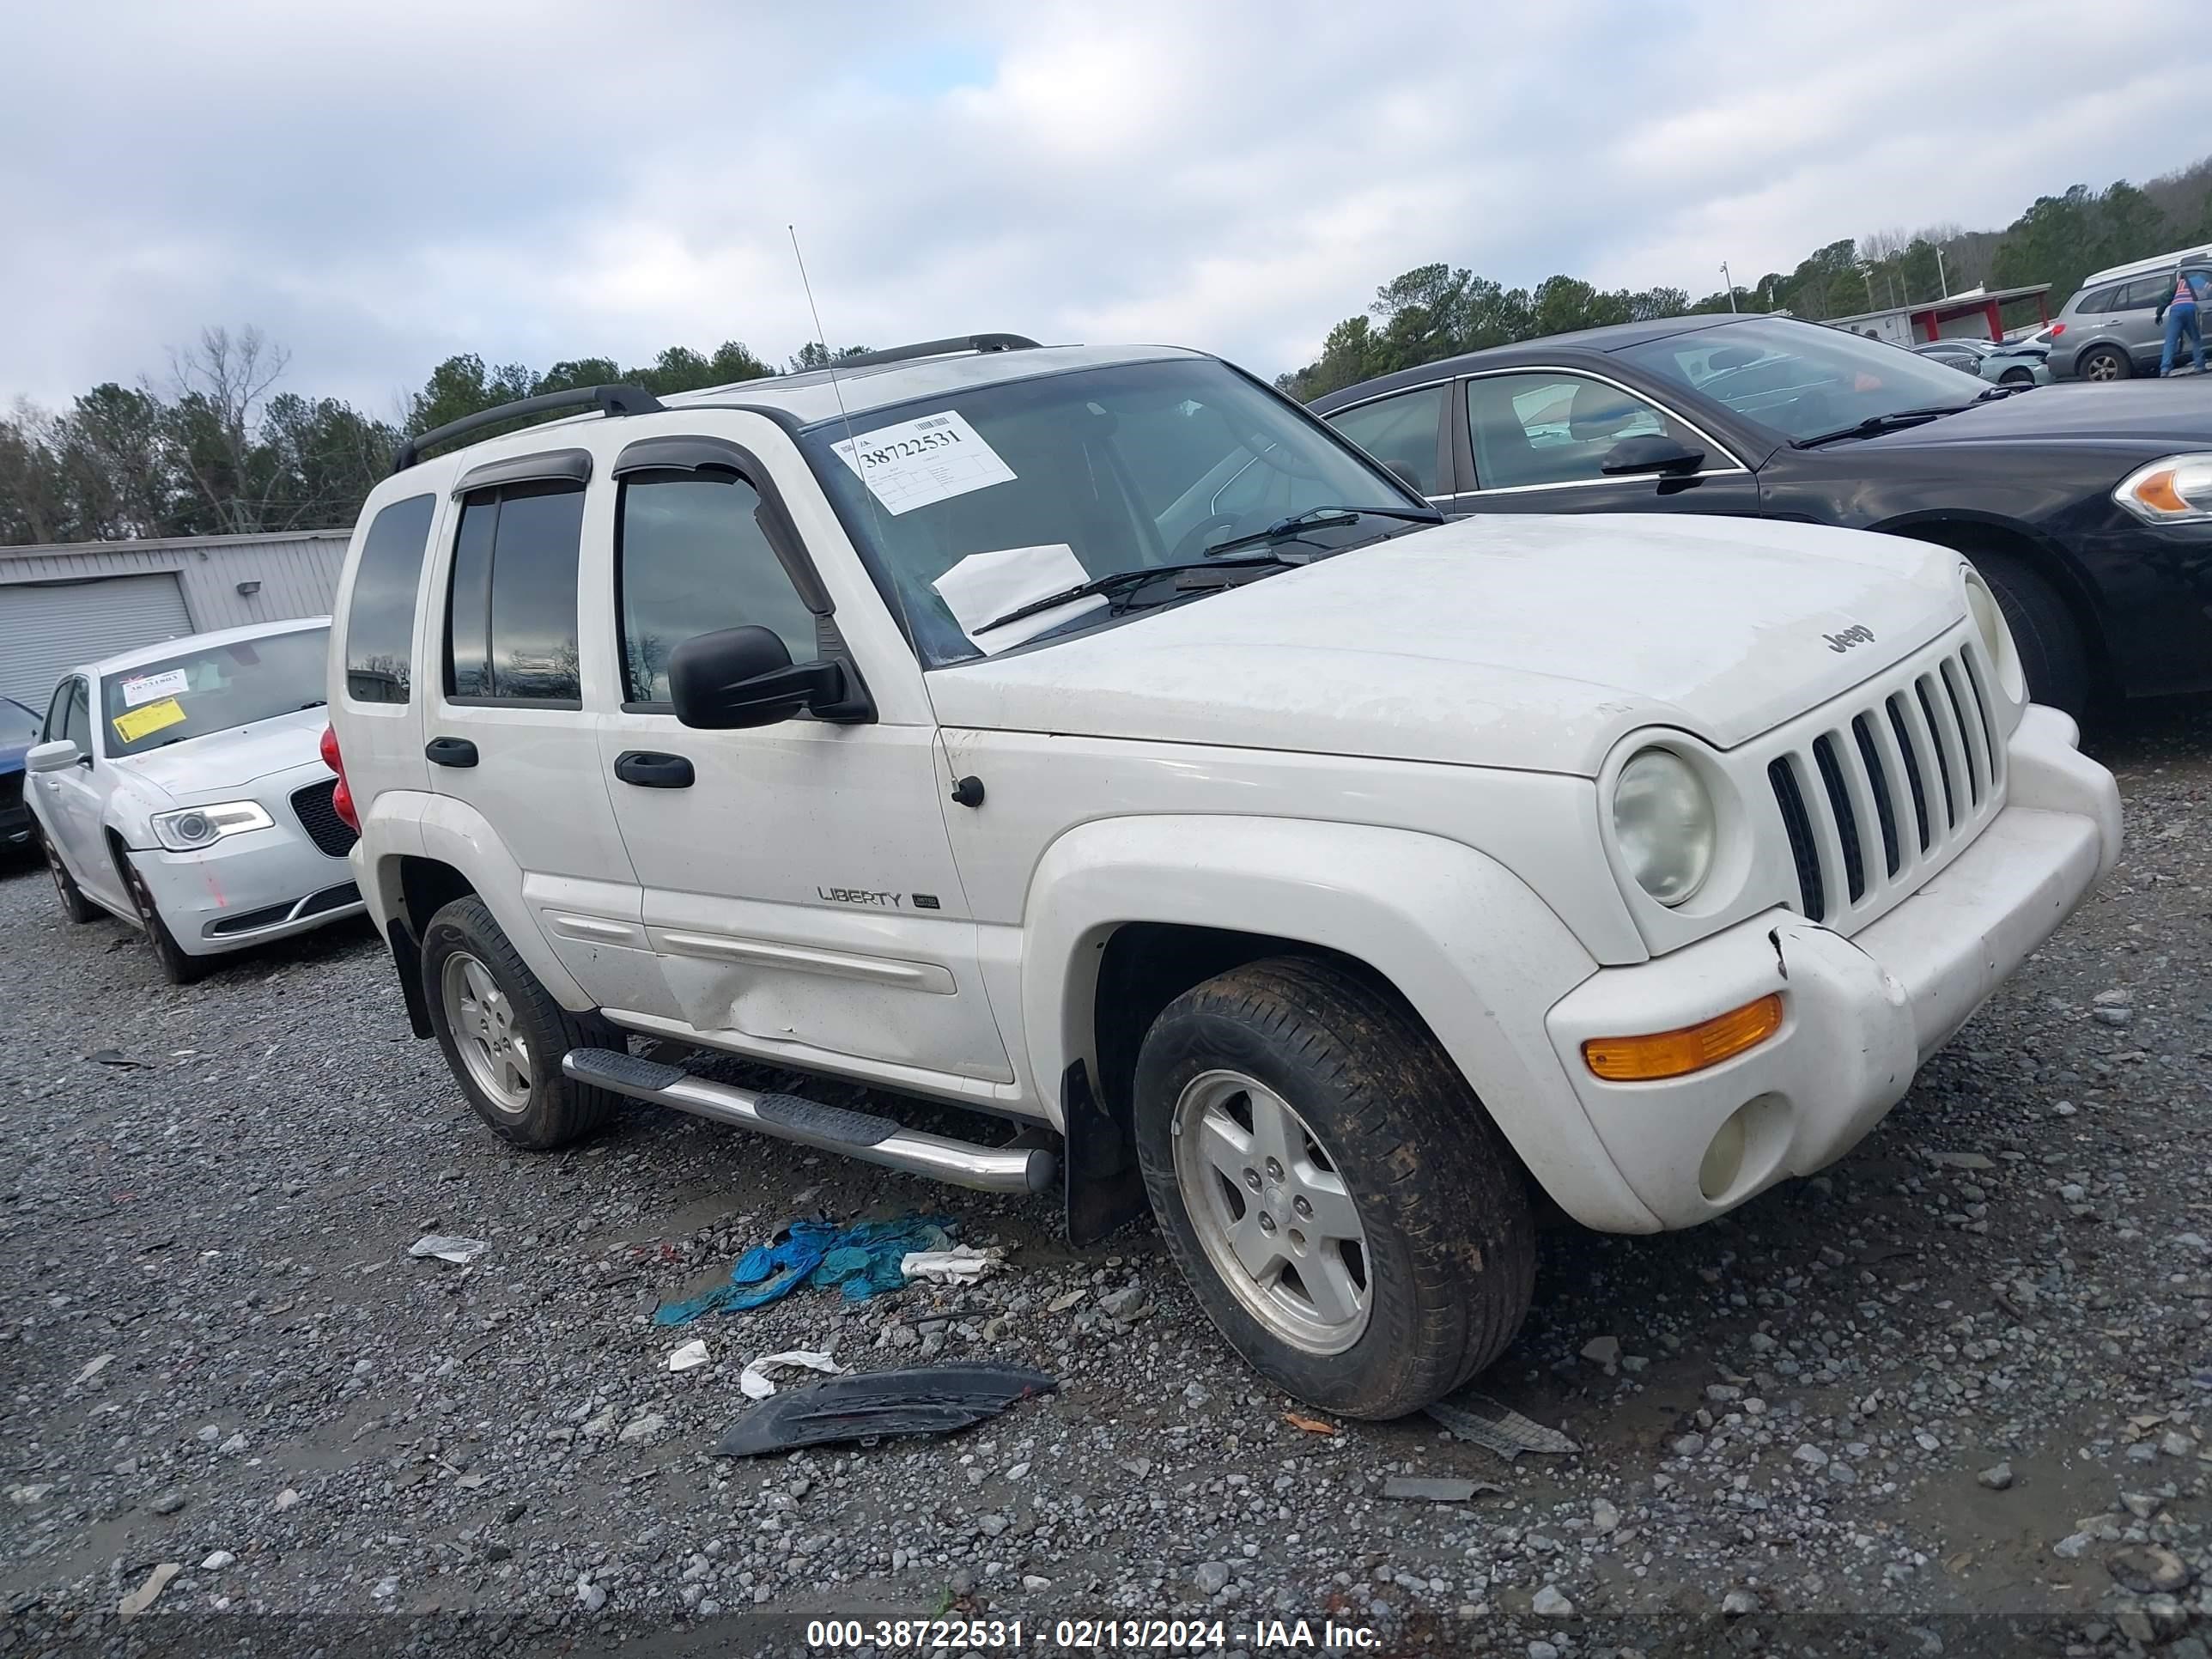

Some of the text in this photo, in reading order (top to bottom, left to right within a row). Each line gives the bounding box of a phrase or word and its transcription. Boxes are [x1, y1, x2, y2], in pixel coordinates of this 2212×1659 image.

[860, 429, 962, 468] 38722531
[1820, 623, 1876, 653] Jeep
[817, 885, 902, 908] LIBERTY
